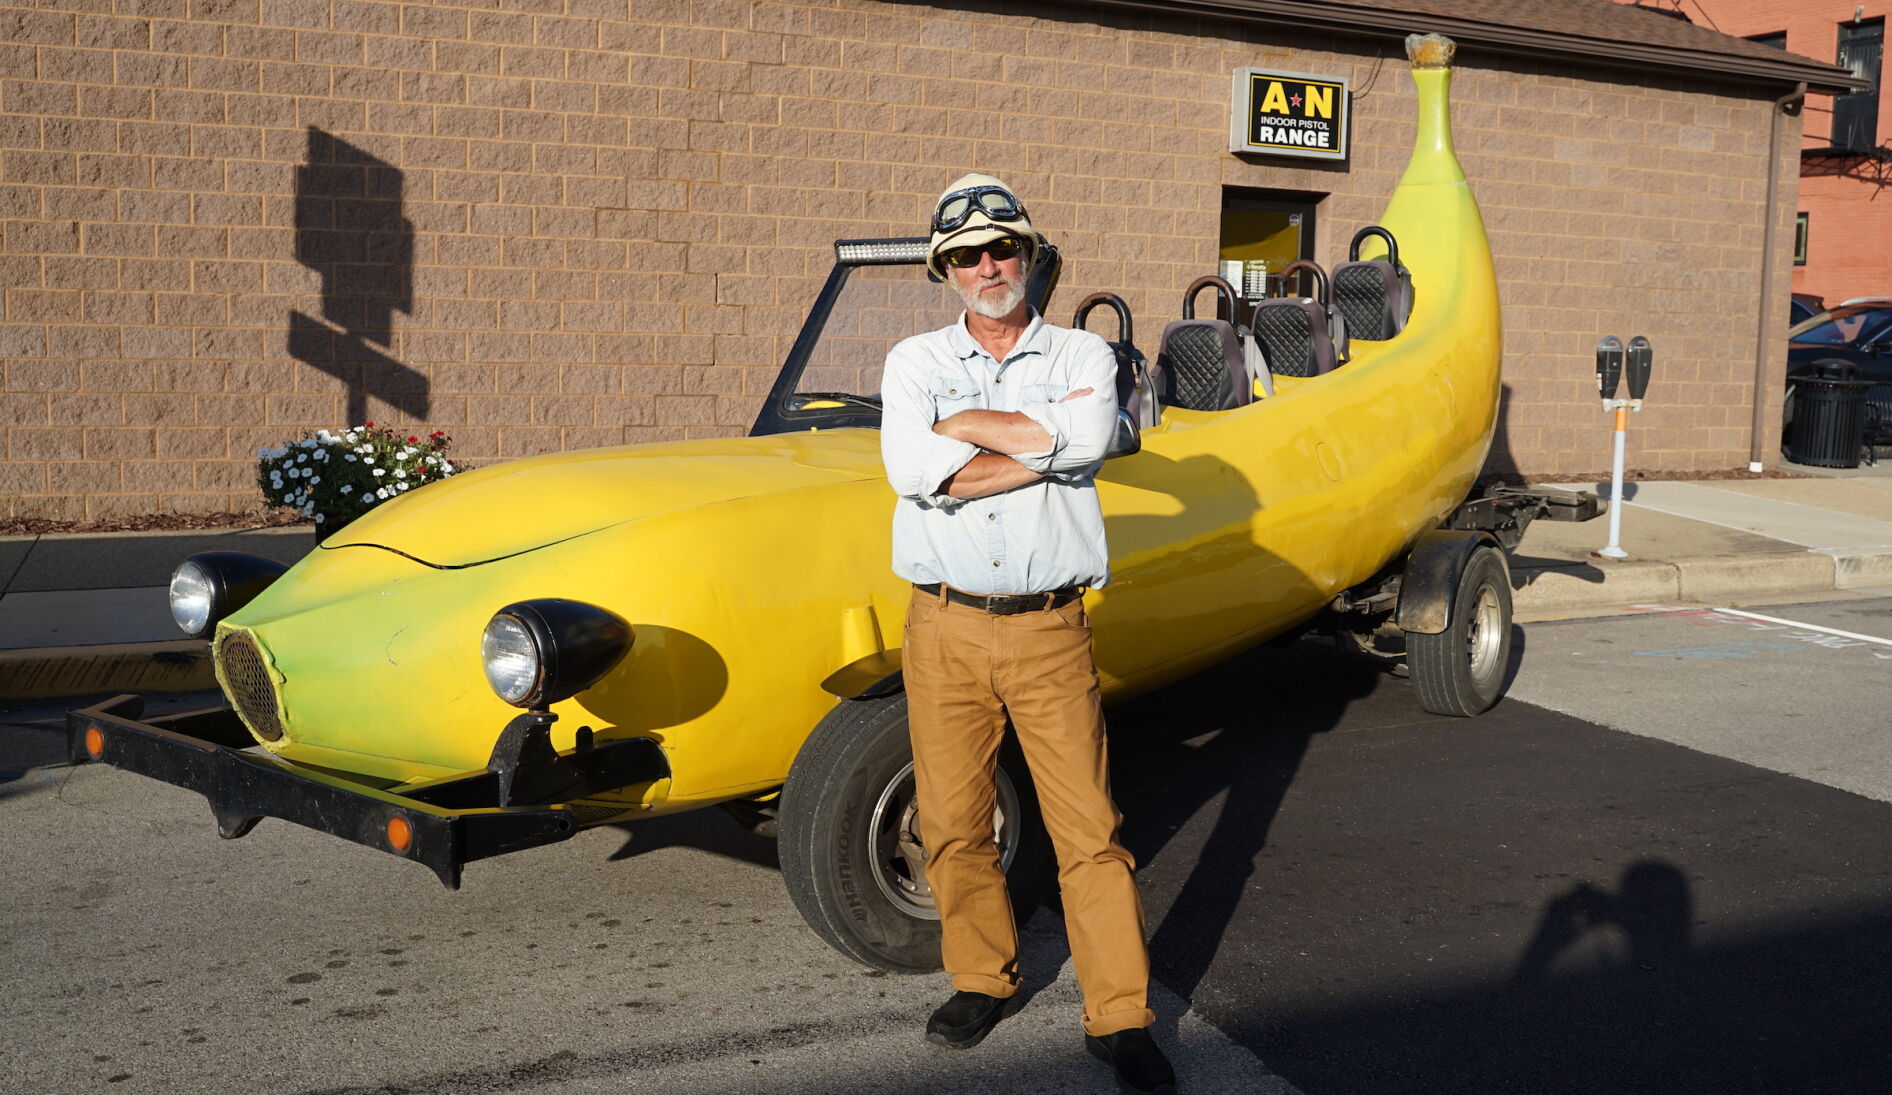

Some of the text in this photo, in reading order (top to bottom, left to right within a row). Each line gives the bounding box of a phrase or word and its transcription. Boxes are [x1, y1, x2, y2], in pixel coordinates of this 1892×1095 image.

[1261, 116, 1330, 130] INDOOR PISTOL
[1260, 126, 1330, 147] RANGE
